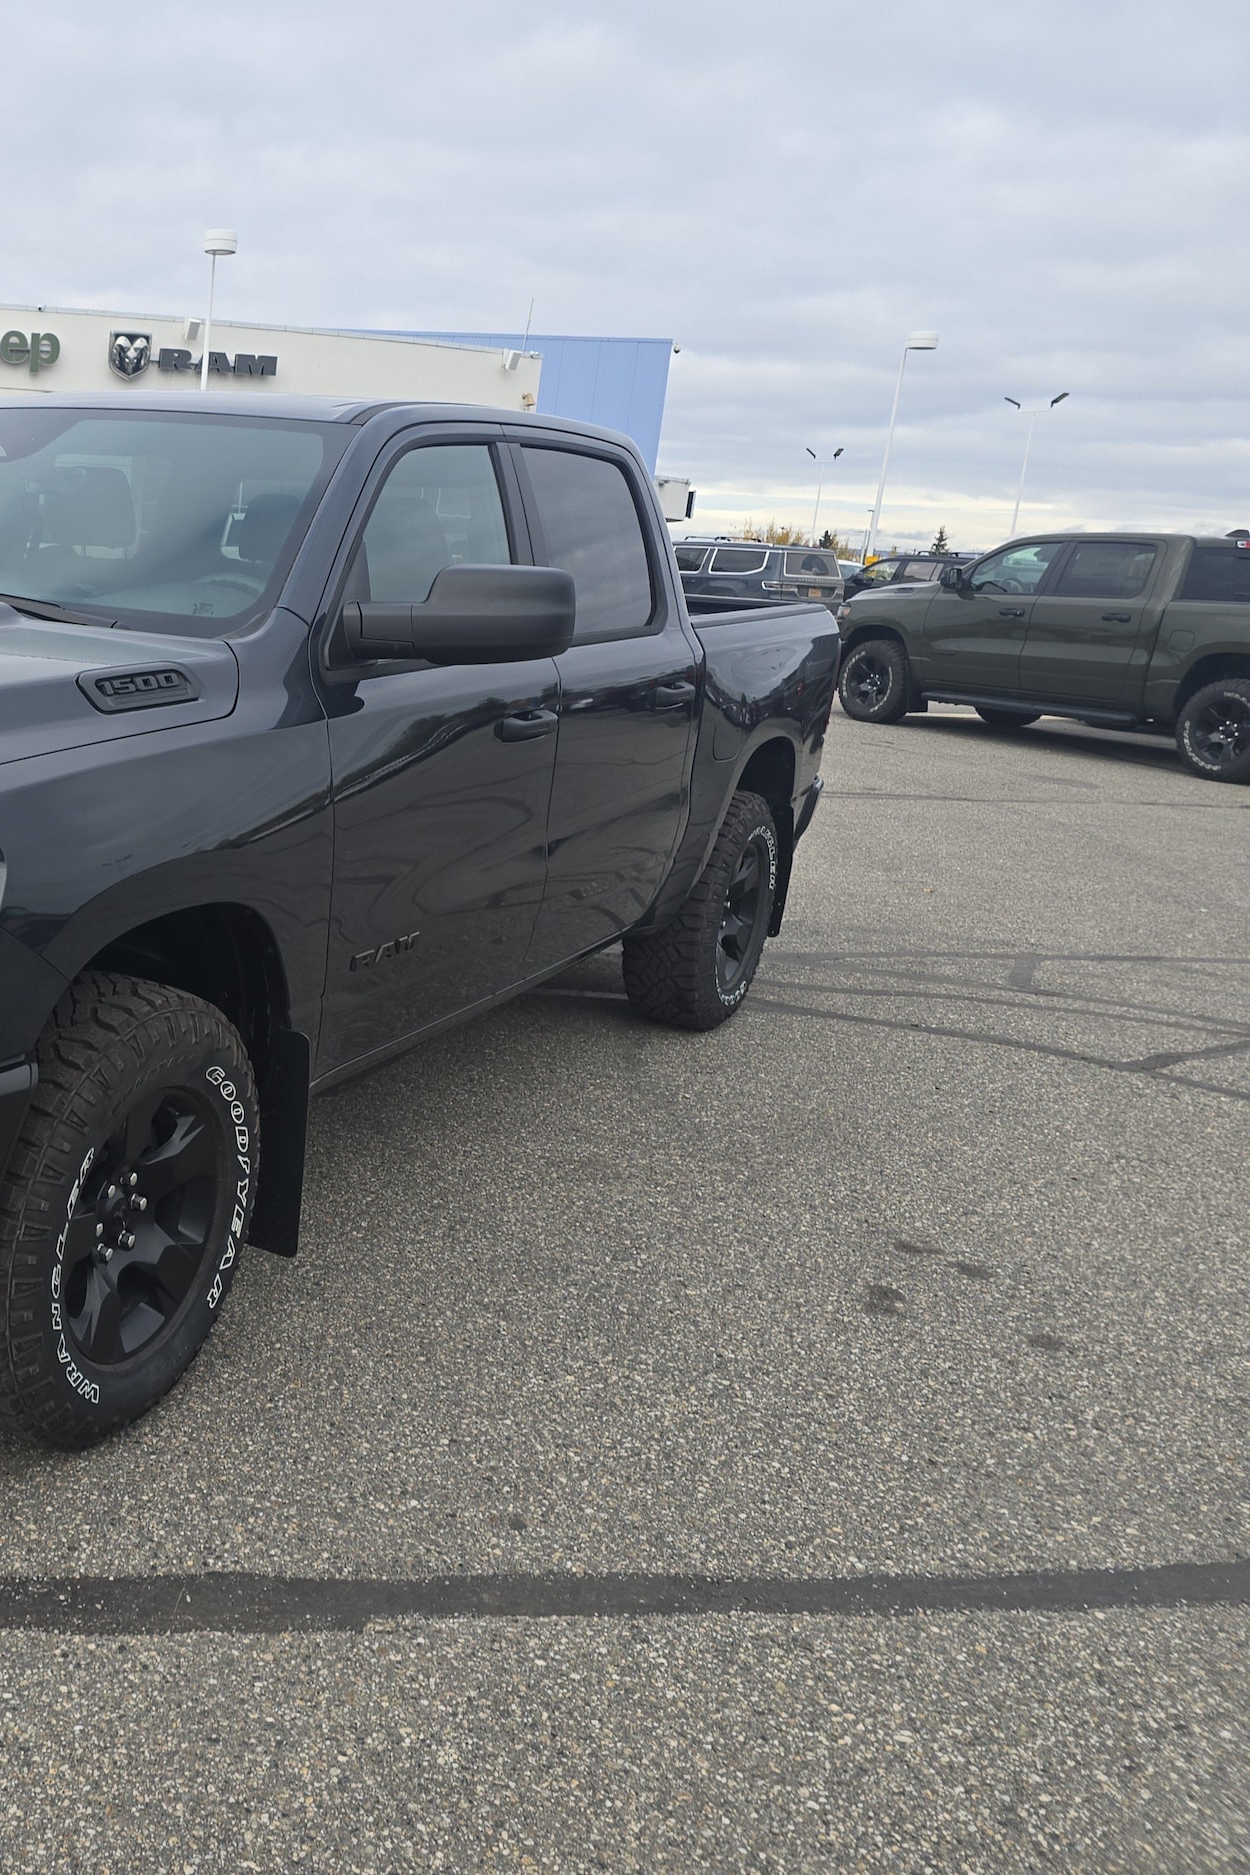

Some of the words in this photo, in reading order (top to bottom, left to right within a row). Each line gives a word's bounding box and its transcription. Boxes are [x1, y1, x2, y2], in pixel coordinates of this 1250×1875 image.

[158, 347, 278, 377] RAM
[96, 672, 181, 696] 1500
[205, 1065, 251, 1309] GOODYEAR
[51, 1147, 101, 1404] WRANGLER
